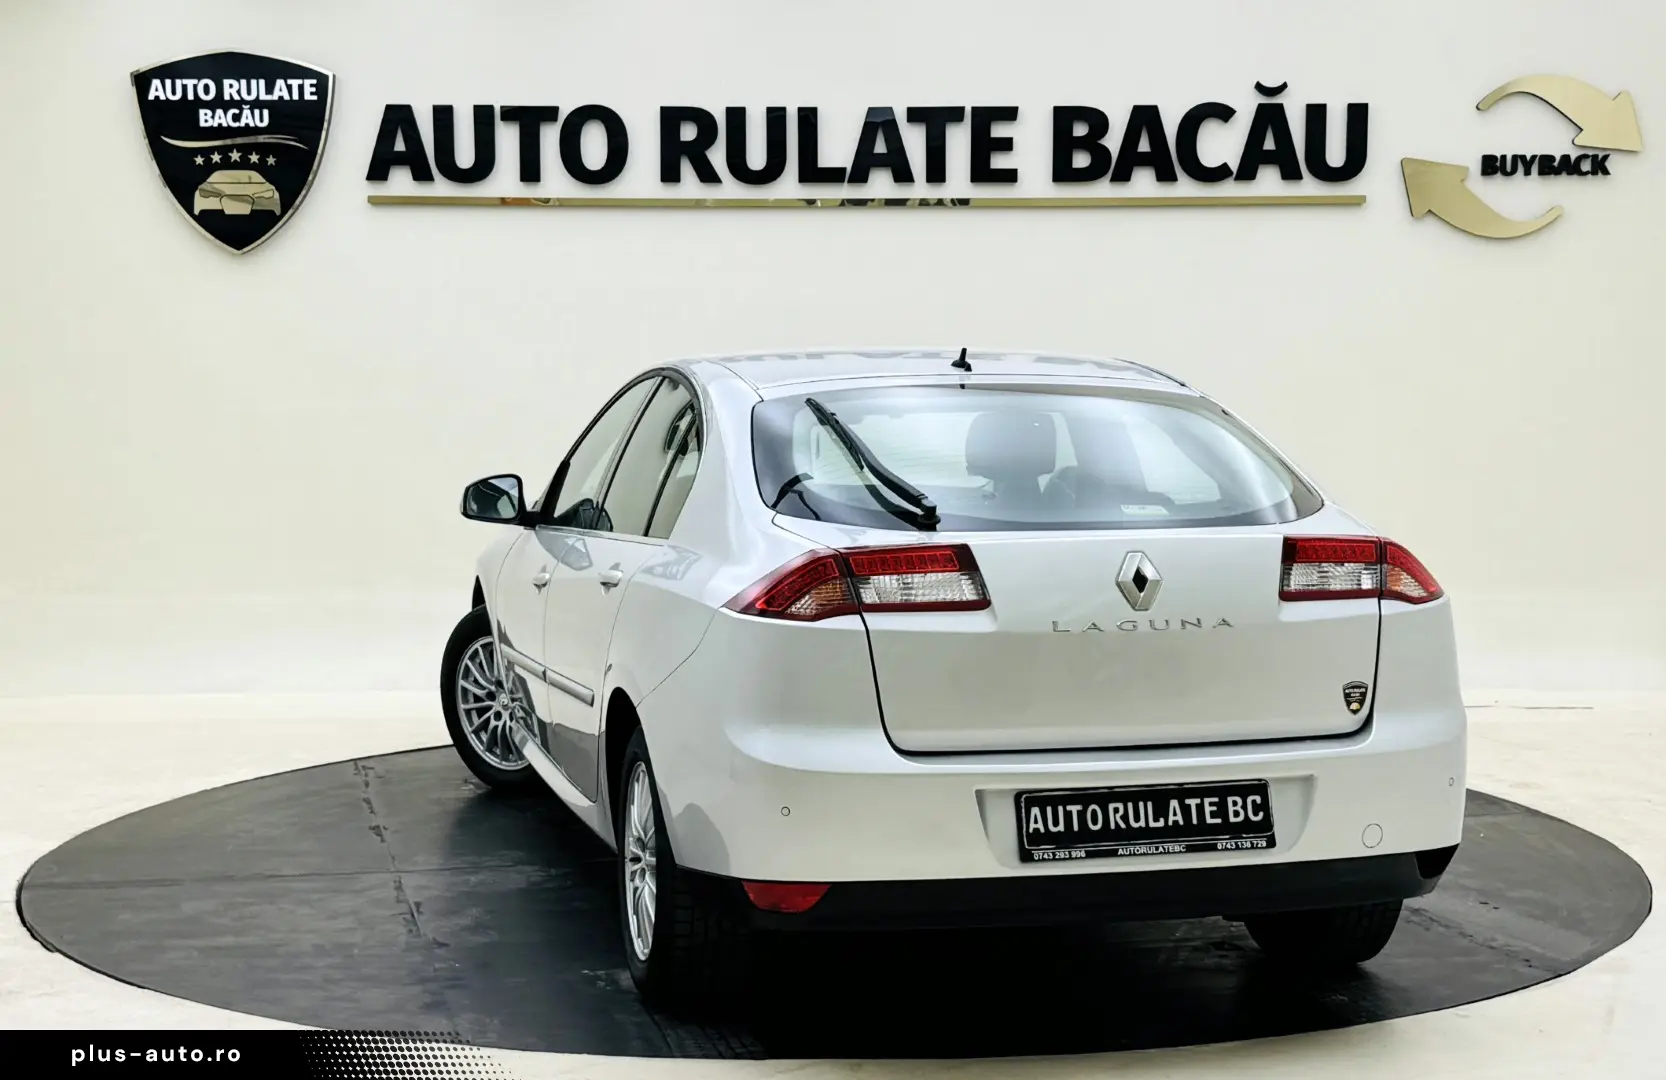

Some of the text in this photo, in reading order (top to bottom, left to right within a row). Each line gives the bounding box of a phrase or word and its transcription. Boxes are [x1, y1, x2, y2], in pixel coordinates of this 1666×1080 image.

[148, 78, 318, 100] AUTO RULATE
[198, 104, 269, 128] BACĂU
[366, 80, 1369, 185] AUTO RULATE BACĂU
[1480, 153, 1611, 176] BUYBACK
[1052, 617, 1234, 633] LAGUNA
[1228, 795, 1264, 823] BC
[1034, 851, 1053, 860] 0743
[1217, 842, 1236, 850] 0743
